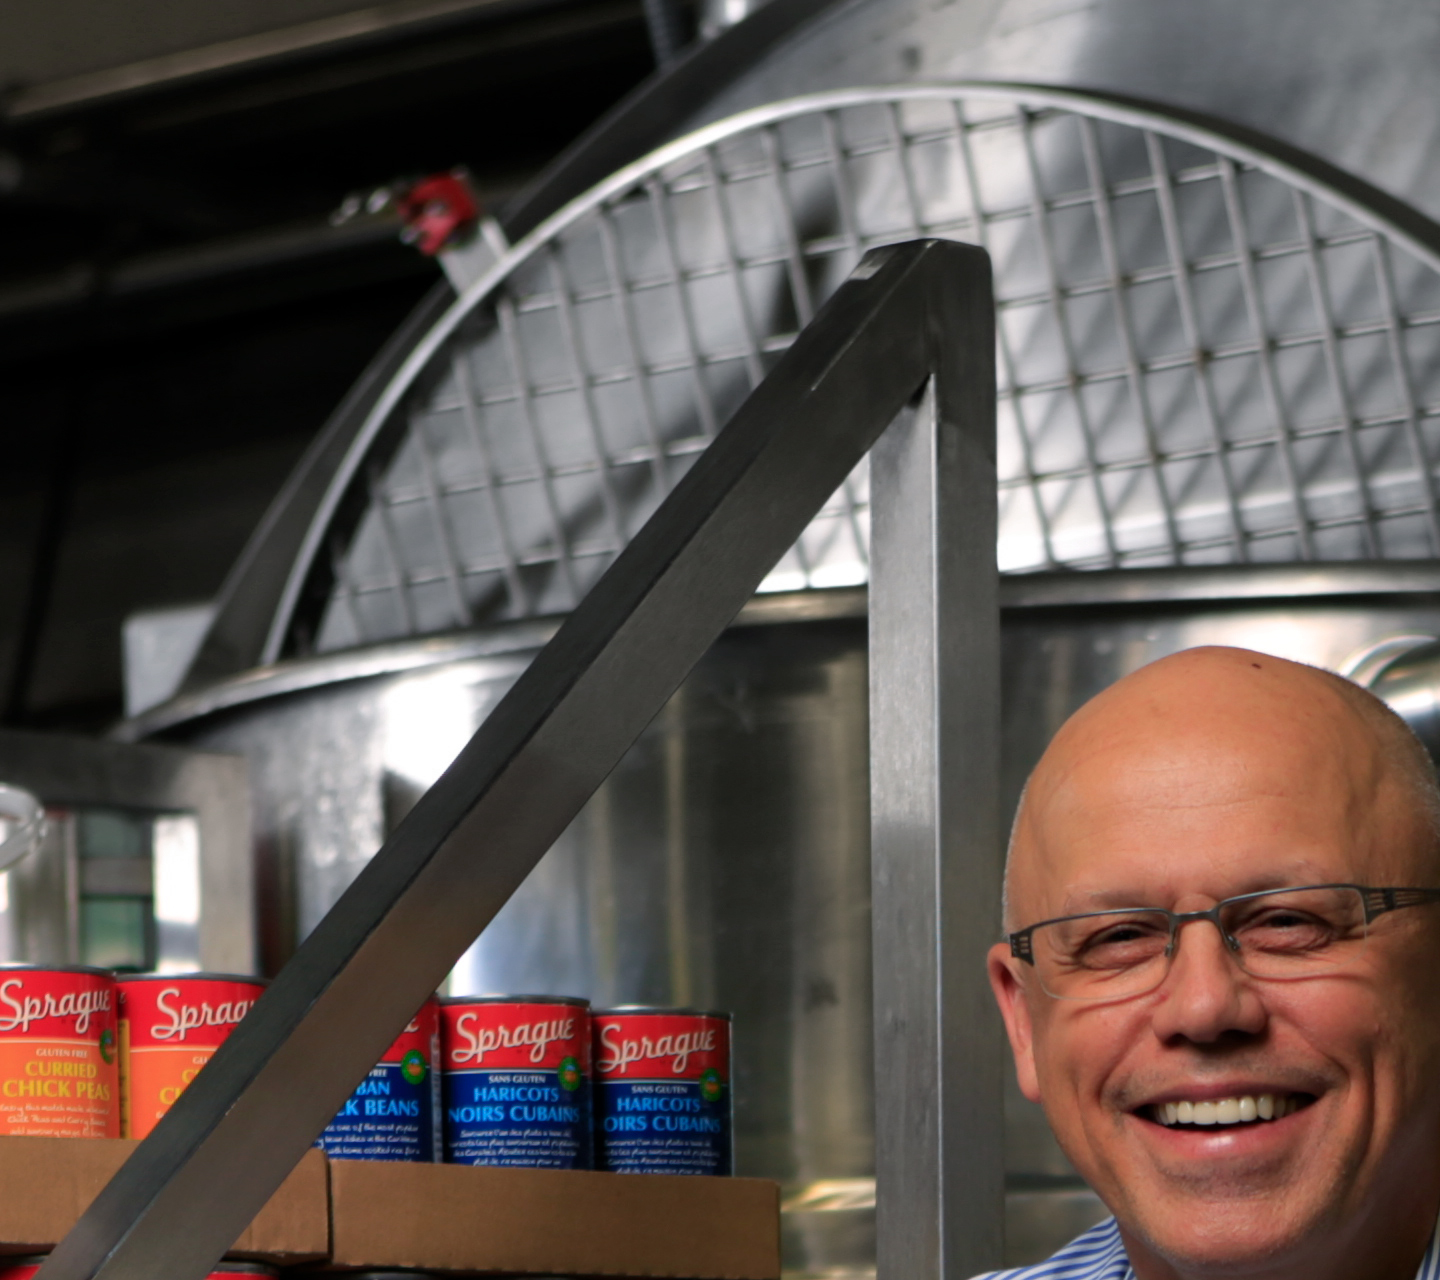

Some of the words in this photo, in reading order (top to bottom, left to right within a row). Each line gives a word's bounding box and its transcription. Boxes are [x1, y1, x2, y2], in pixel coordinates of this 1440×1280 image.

[451, 1013, 574, 1063] Sprague
[36, 1048, 70, 1057] GLUTEN
[72, 1049, 88, 1058] FREE
[596, 1024, 715, 1073] Sprague
[25, 1061, 97, 1078] CURRIED
[356, 1081, 390, 1095] BAN
[489, 1075, 510, 1084] SANS
[513, 1075, 545, 1084] GLUTEN
[2, 1080, 71, 1097] CHICK
[76, 1081, 110, 1100] PEAS
[474, 1087, 559, 1102] HARICOTS
[631, 1086, 654, 1094] SANS
[655, 1086, 687, 1094] GLUTEN
[365, 1100, 419, 1117] BEANS
[617, 1097, 700, 1112] HARICOTS
[449, 1106, 504, 1123] NOIRS
[510, 1106, 579, 1123] CUBAINS
[652, 1116, 720, 1133] CUBAINS
